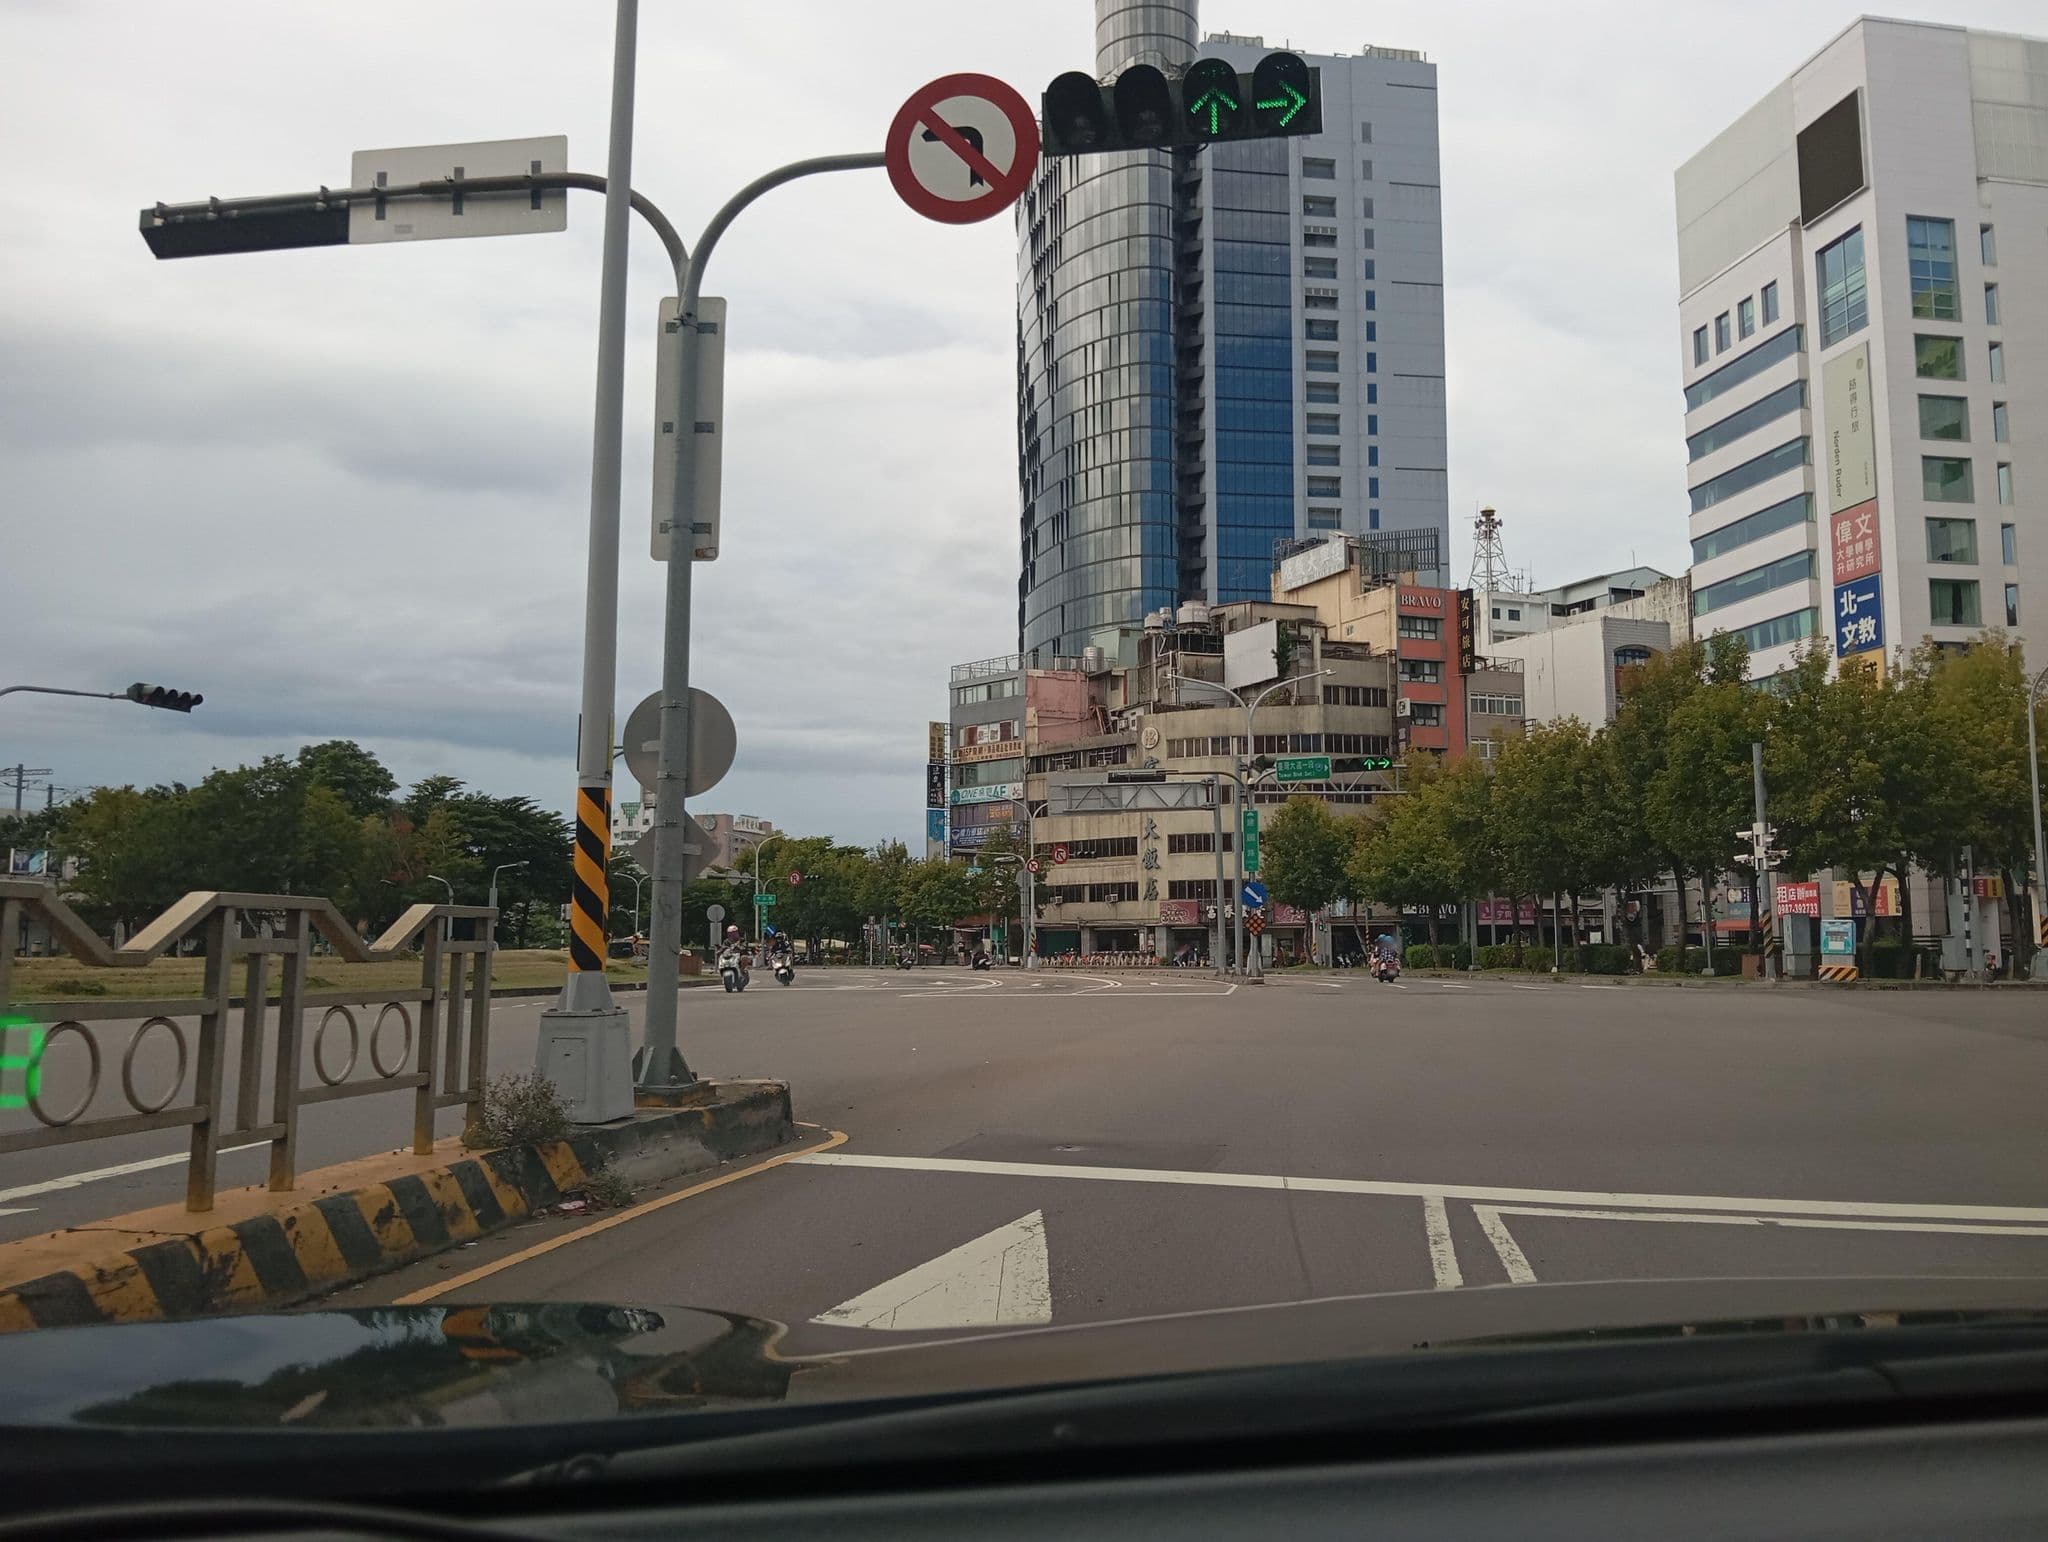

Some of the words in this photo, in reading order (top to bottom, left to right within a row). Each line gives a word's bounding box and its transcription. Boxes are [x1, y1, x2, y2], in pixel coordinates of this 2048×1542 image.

[1835, 513, 1873, 547] 偉文
[1401, 595, 1441, 609] BRAVO
[1840, 590, 1875, 618] 北一
[1460, 596, 1472, 669] 安可旅店
[1841, 616, 1877, 650] 文教
